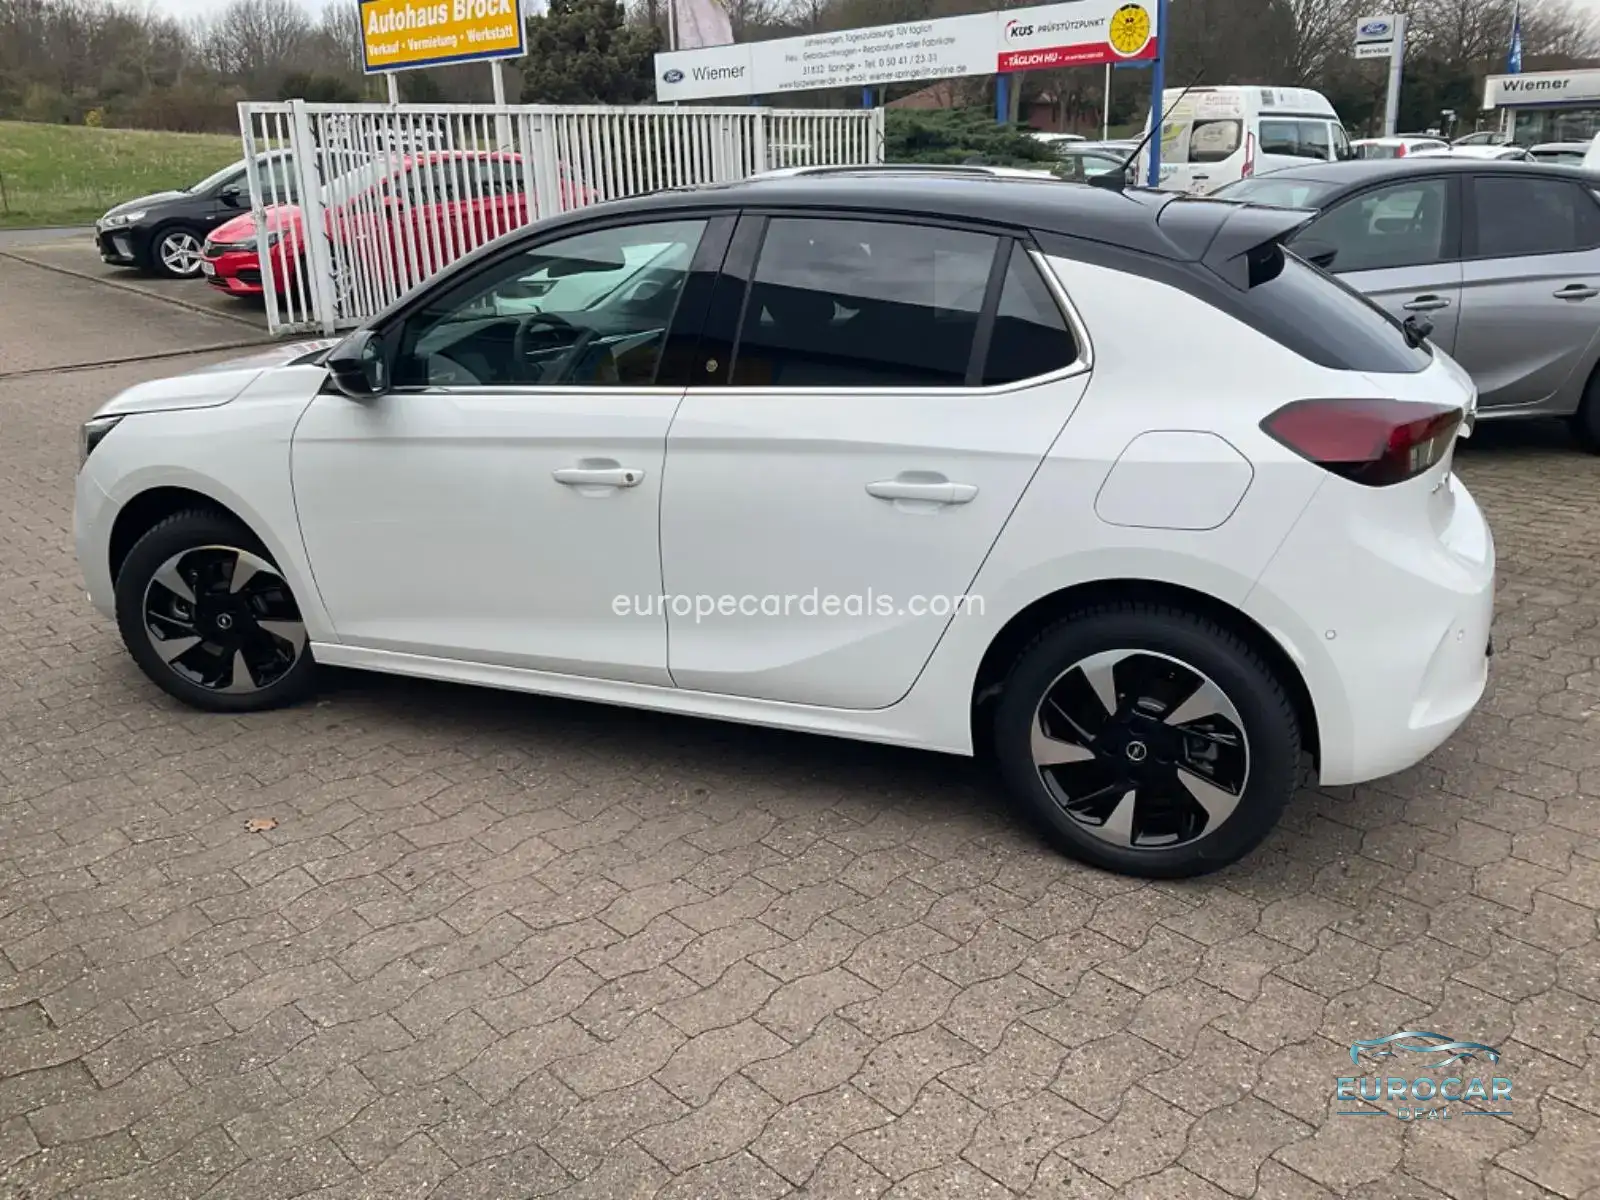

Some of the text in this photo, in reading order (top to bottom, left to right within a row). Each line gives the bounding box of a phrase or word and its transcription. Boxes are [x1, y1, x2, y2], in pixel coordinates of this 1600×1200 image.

[367, 0, 512, 35] Autohaus Brock
[1037, 17, 1105, 34] PRÜFSTÜTZPUNKT
[366, 24, 514, 56] Verkauf Vermietung Werkstatt
[1008, 53, 1045, 67] TÄGLICH
[692, 65, 745, 81] Wiemer
[1502, 78, 1570, 92] Wiemer
